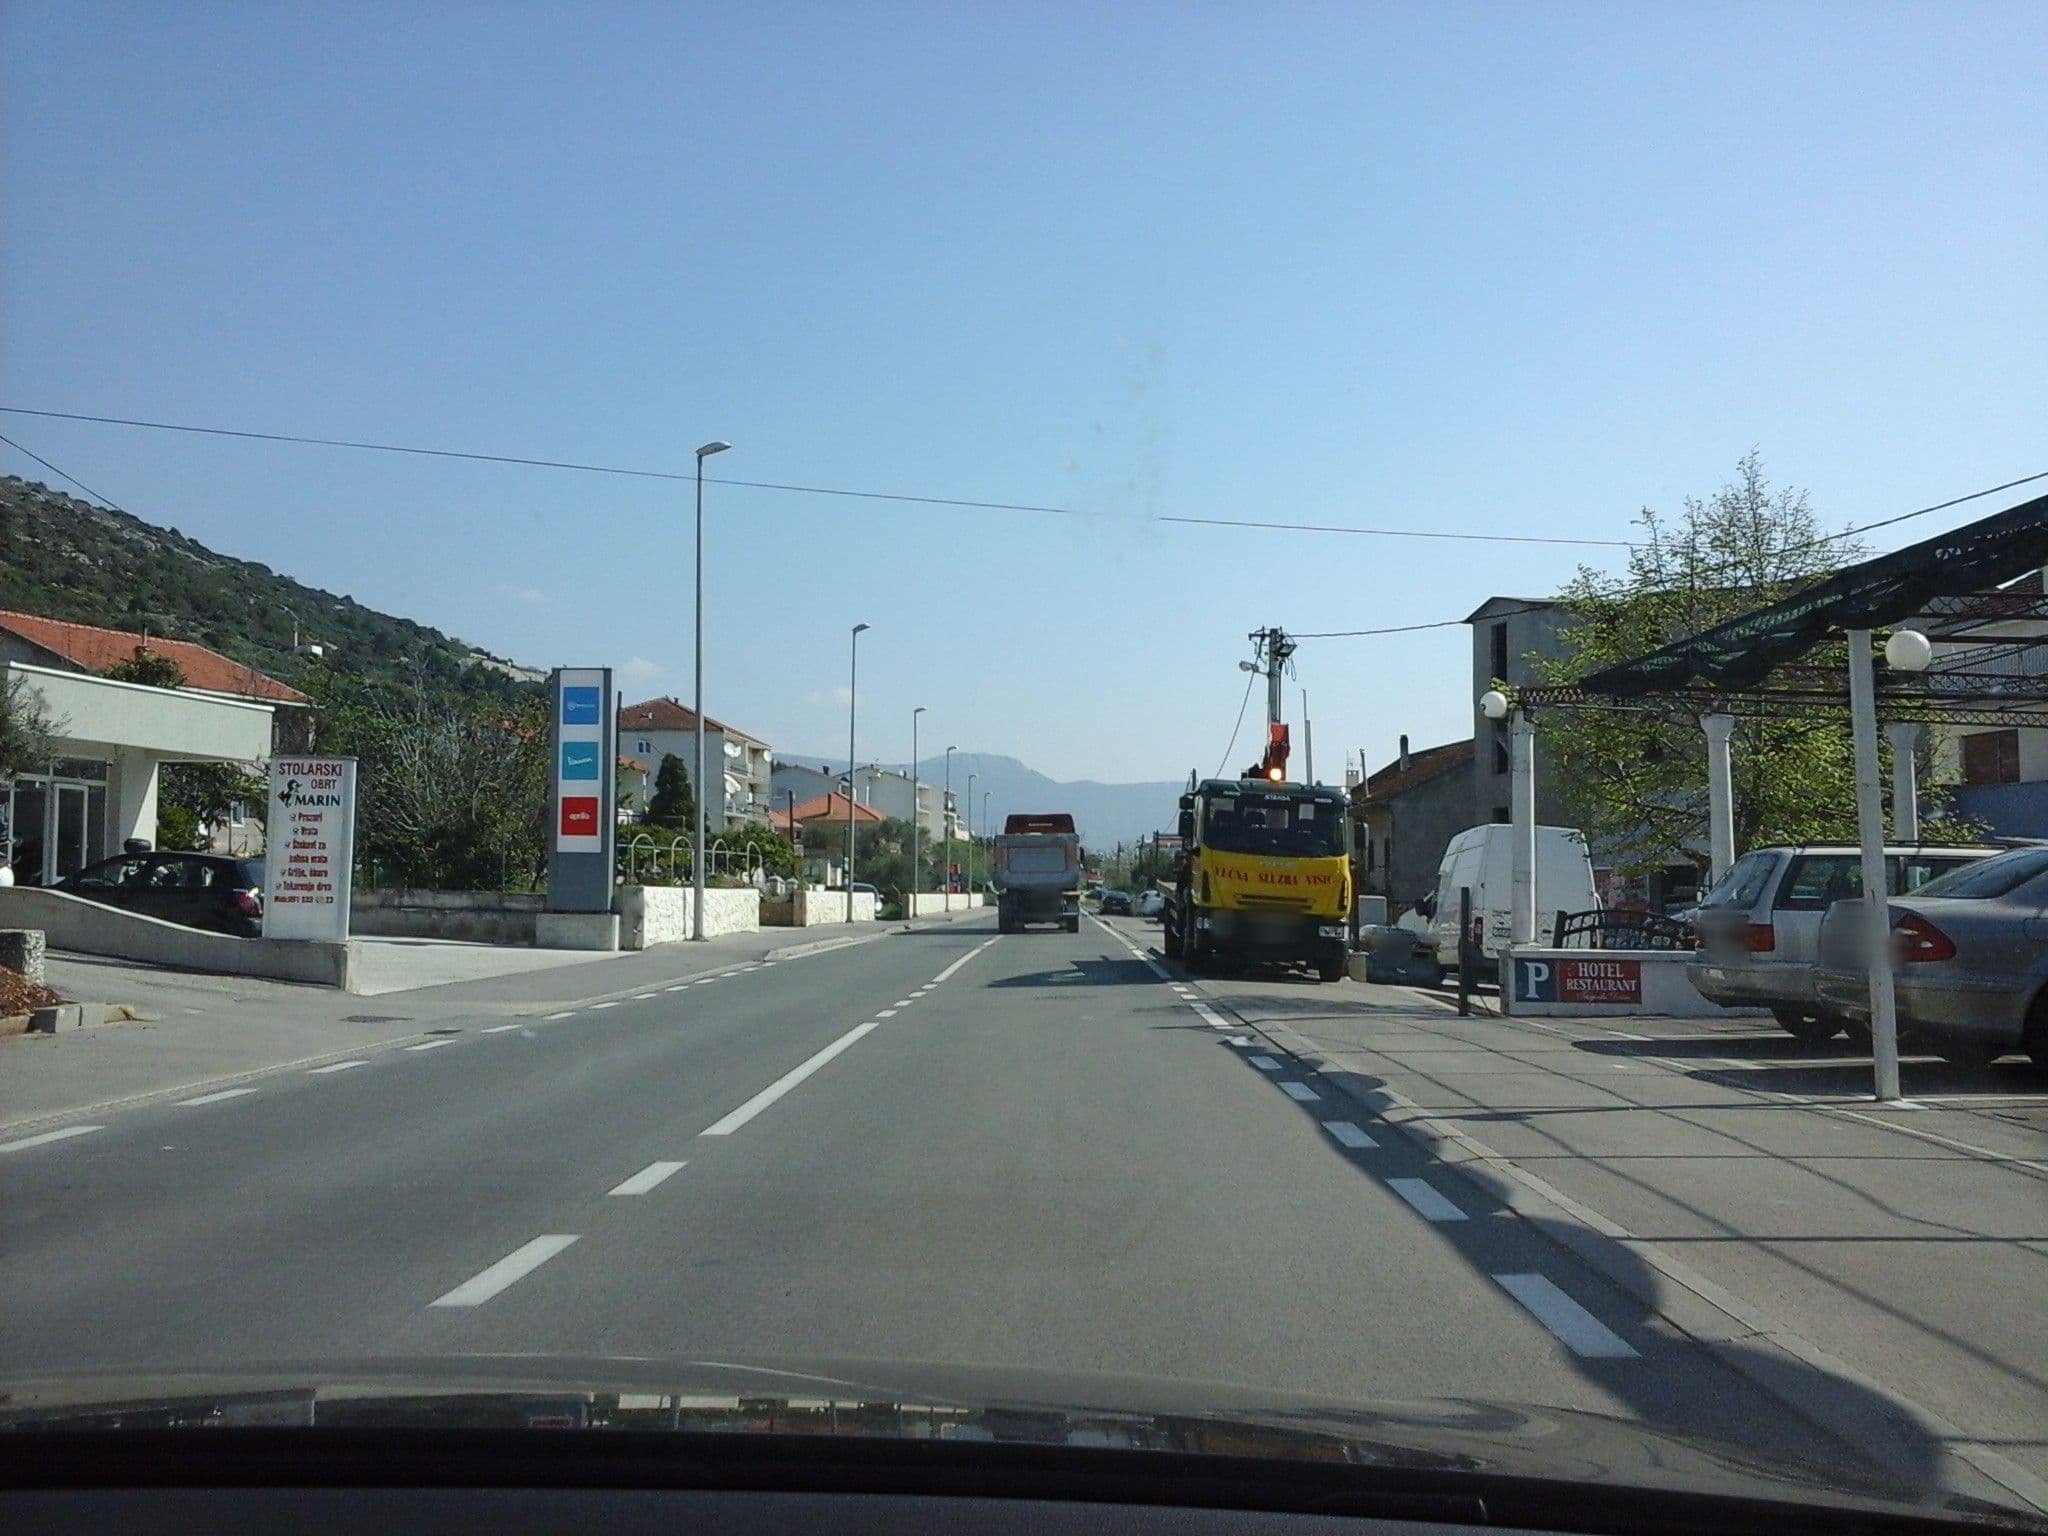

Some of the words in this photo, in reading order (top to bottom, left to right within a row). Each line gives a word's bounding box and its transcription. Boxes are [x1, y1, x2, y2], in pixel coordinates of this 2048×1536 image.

[278, 762, 343, 777] STOLARSKI
[310, 779, 337, 790] OBRT
[294, 794, 341, 807] MARIN
[1579, 962, 1625, 978] HOTEL
[1524, 961, 1550, 999] P
[1566, 979, 1637, 992] RESTAURANT
